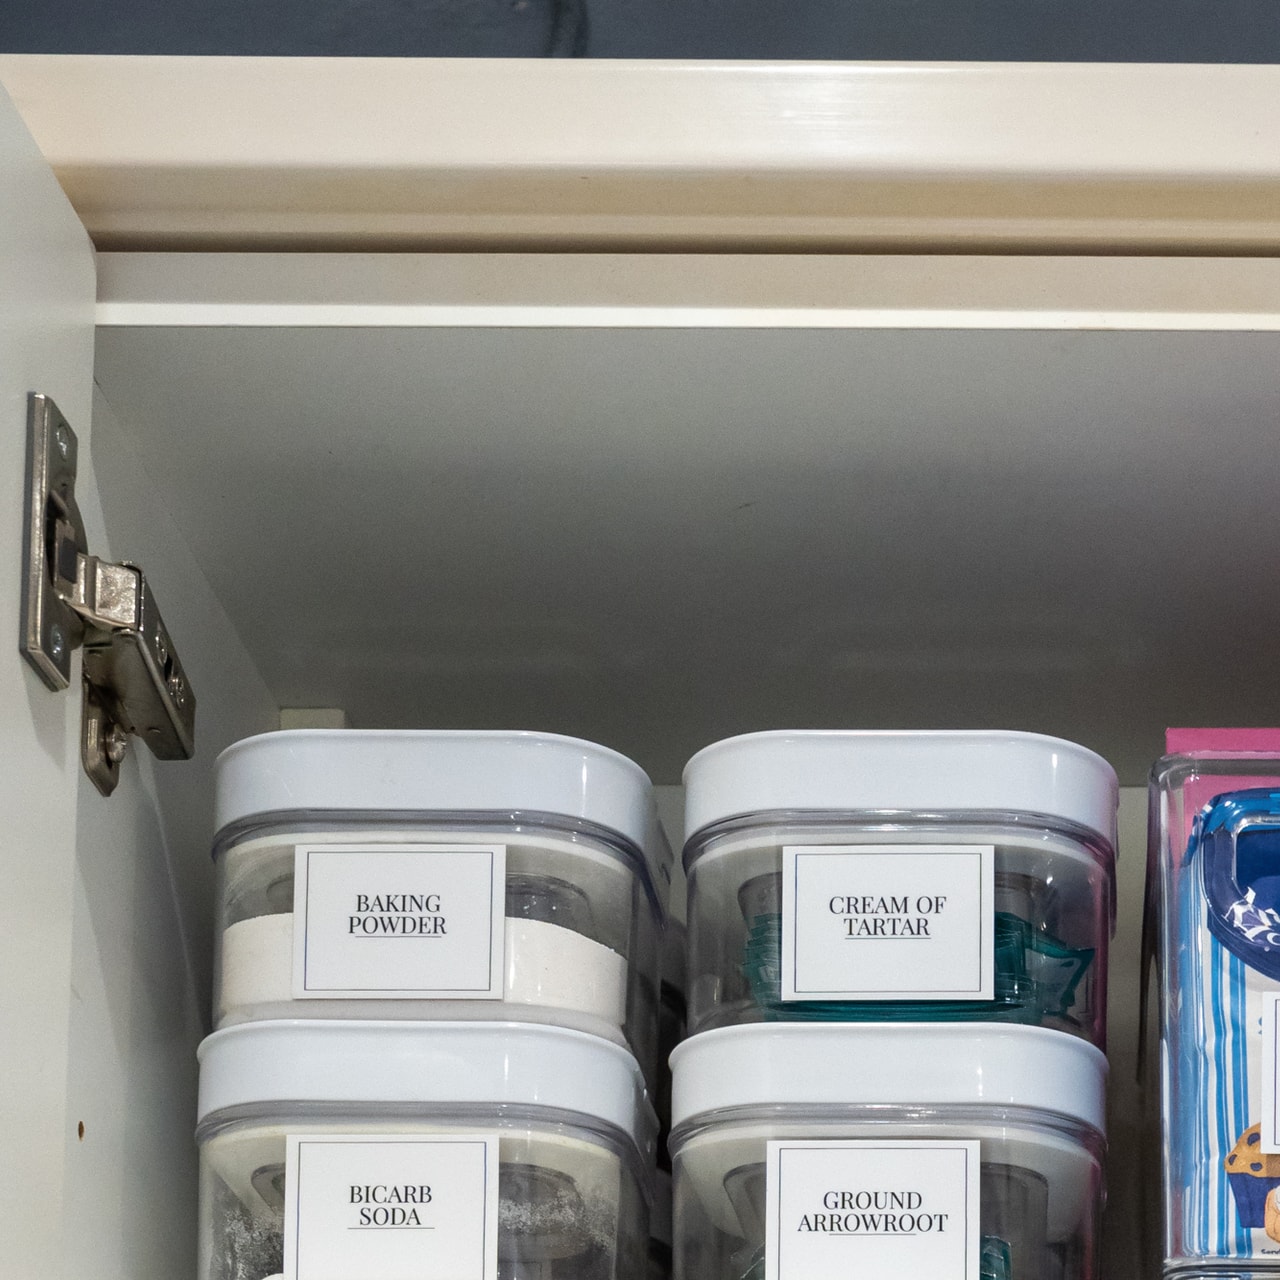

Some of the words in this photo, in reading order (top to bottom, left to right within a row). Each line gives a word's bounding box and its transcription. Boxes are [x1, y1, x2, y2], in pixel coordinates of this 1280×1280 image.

[356, 894, 441, 913] BAKING
[829, 896, 909, 915] CREAM
[917, 896, 947, 914] OF
[348, 915, 447, 935] POWDER
[844, 917, 931, 936] TARTAR
[349, 1185, 433, 1204] BICARB
[823, 1191, 923, 1210] GROUND
[359, 1207, 422, 1226] SODA
[797, 1213, 949, 1232] ARROWROOT
